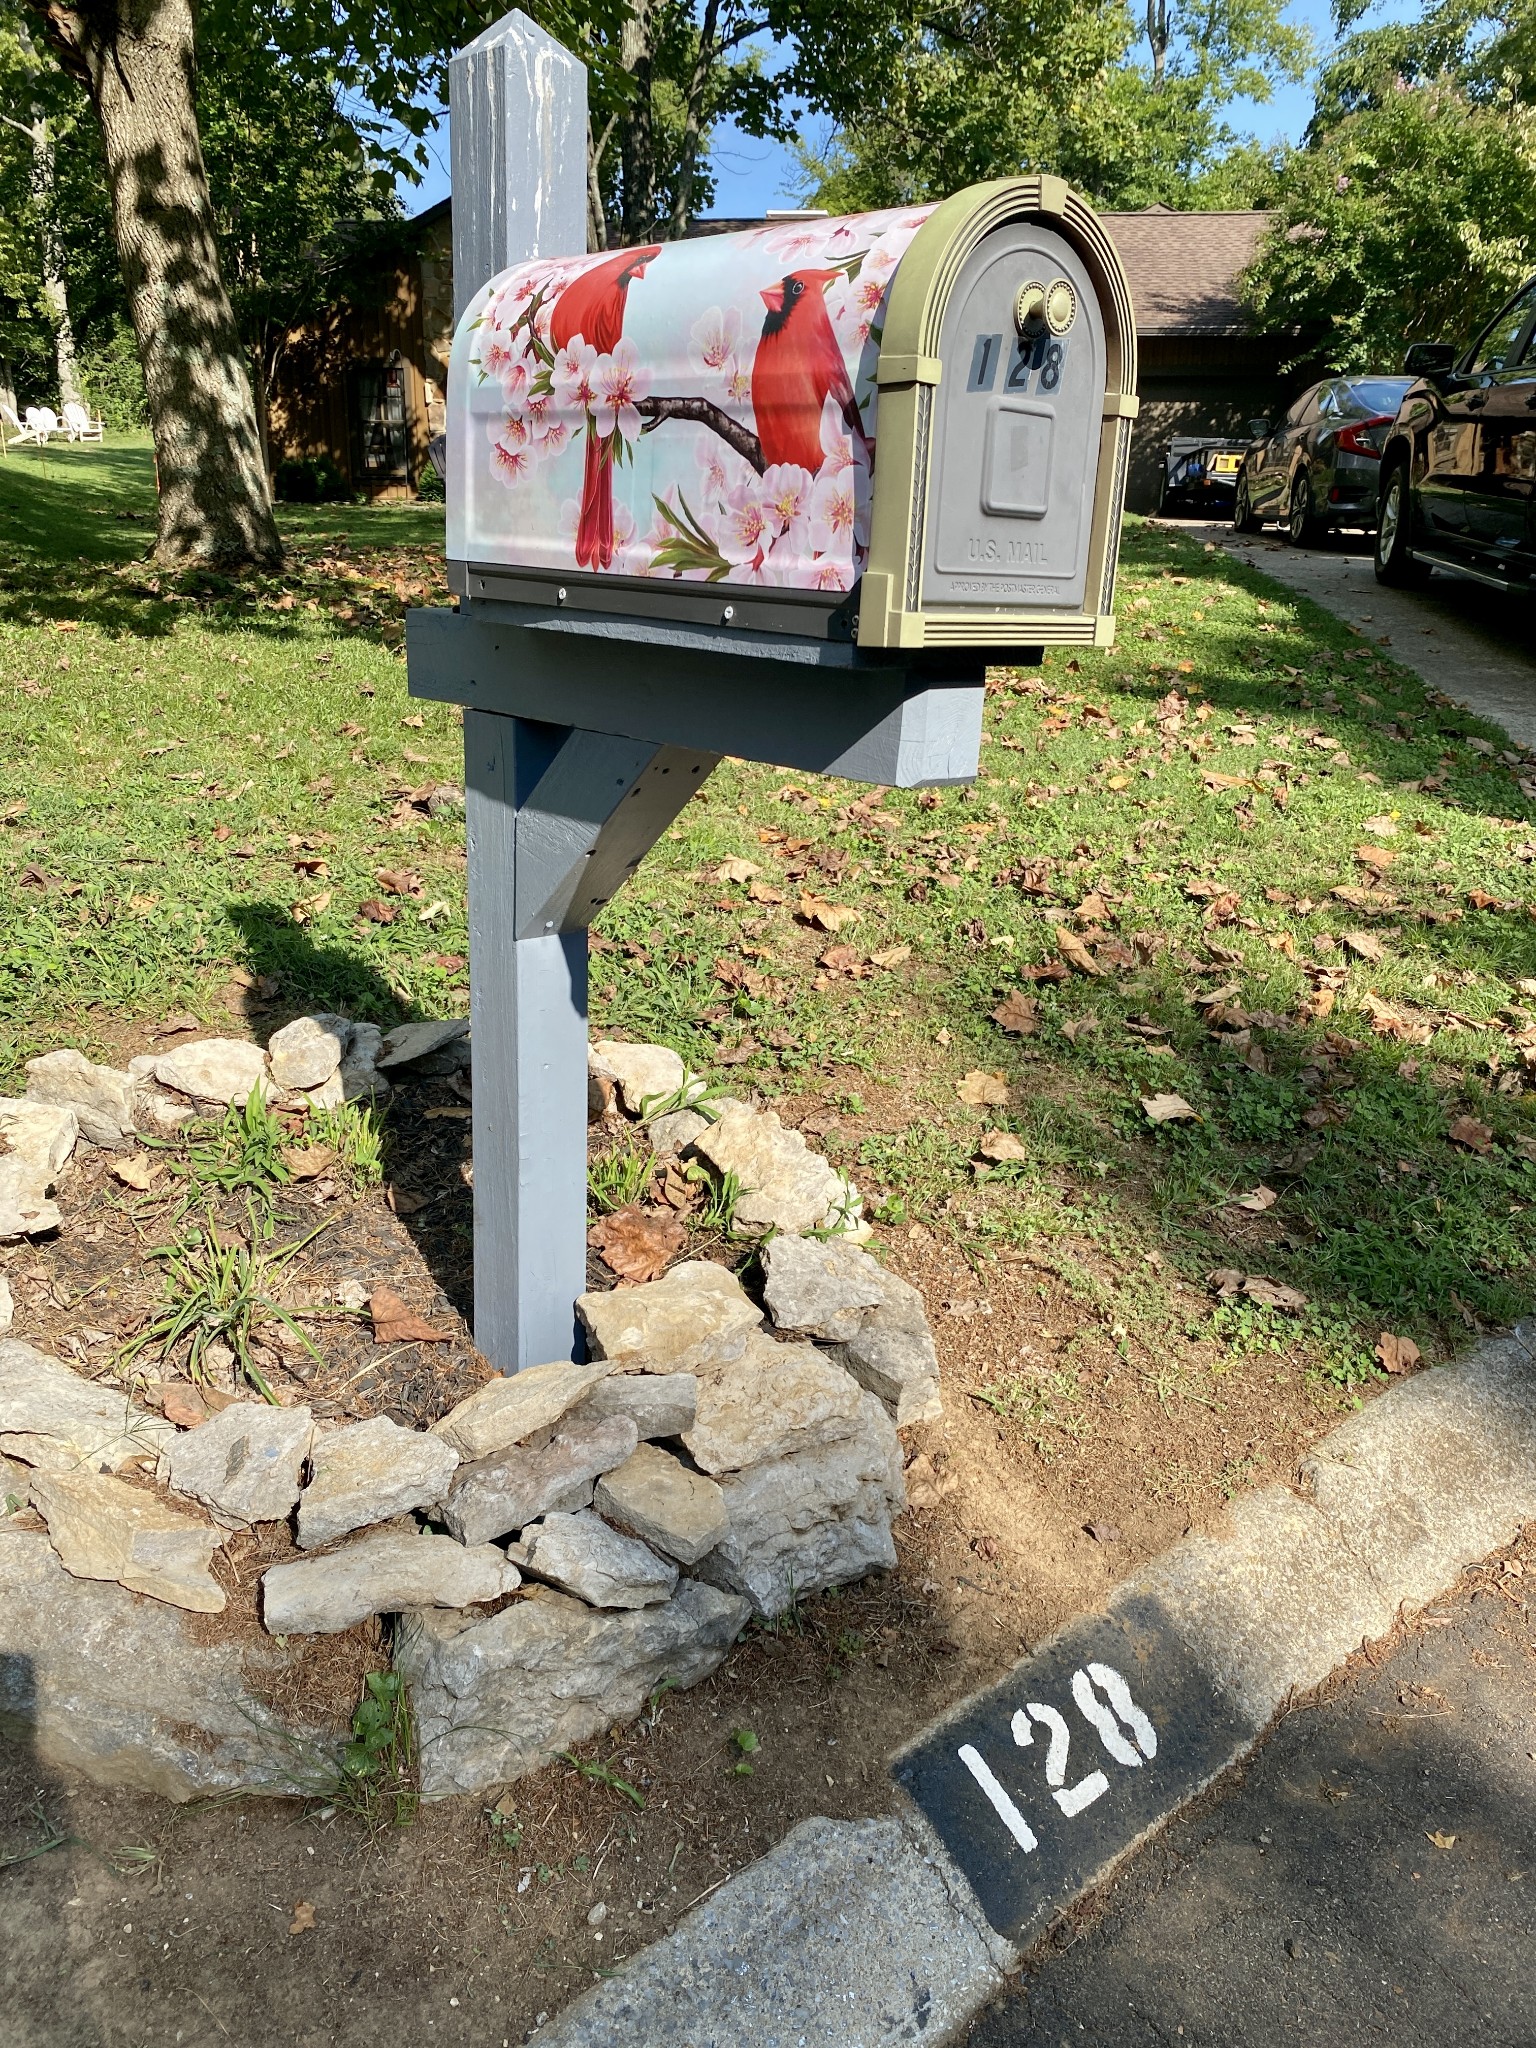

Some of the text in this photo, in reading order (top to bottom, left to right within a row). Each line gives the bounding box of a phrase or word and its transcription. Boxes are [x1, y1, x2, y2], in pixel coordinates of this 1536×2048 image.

[977, 338, 1063, 390] 128
[968, 538, 1048, 566] U.S. MAIL
[957, 1663, 1158, 1853] 128
